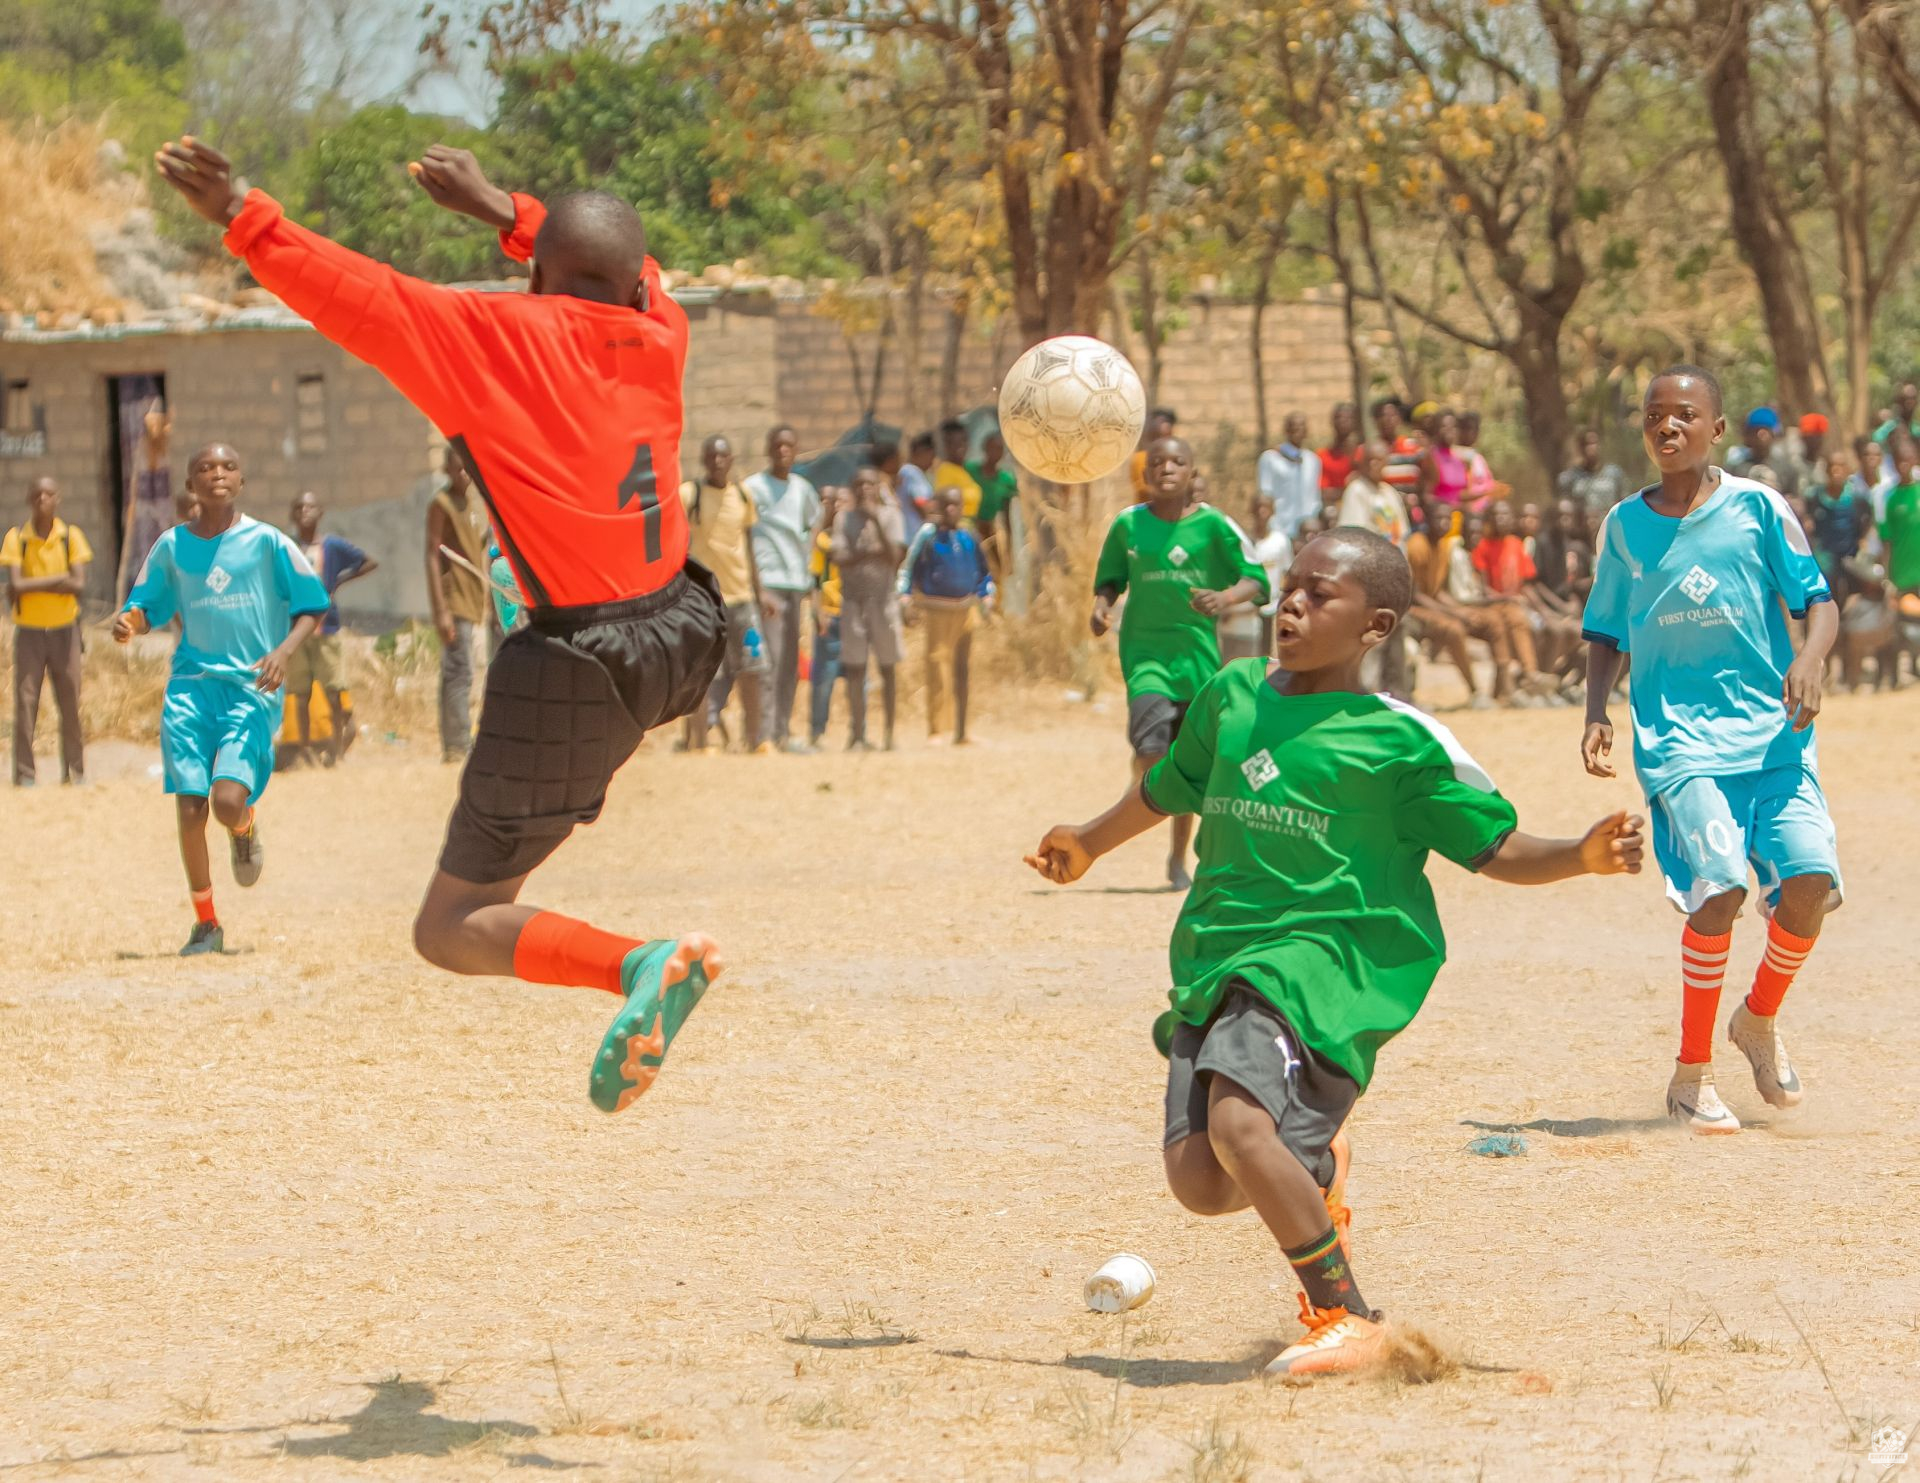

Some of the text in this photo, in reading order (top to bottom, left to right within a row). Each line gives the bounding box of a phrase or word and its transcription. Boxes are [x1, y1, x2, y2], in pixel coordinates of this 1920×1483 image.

[618, 444, 662, 563] 1
[1658, 611, 1685, 626] FIRST
[1231, 799, 1330, 833] QUANTUM
[1689, 819, 1733, 865] 10
